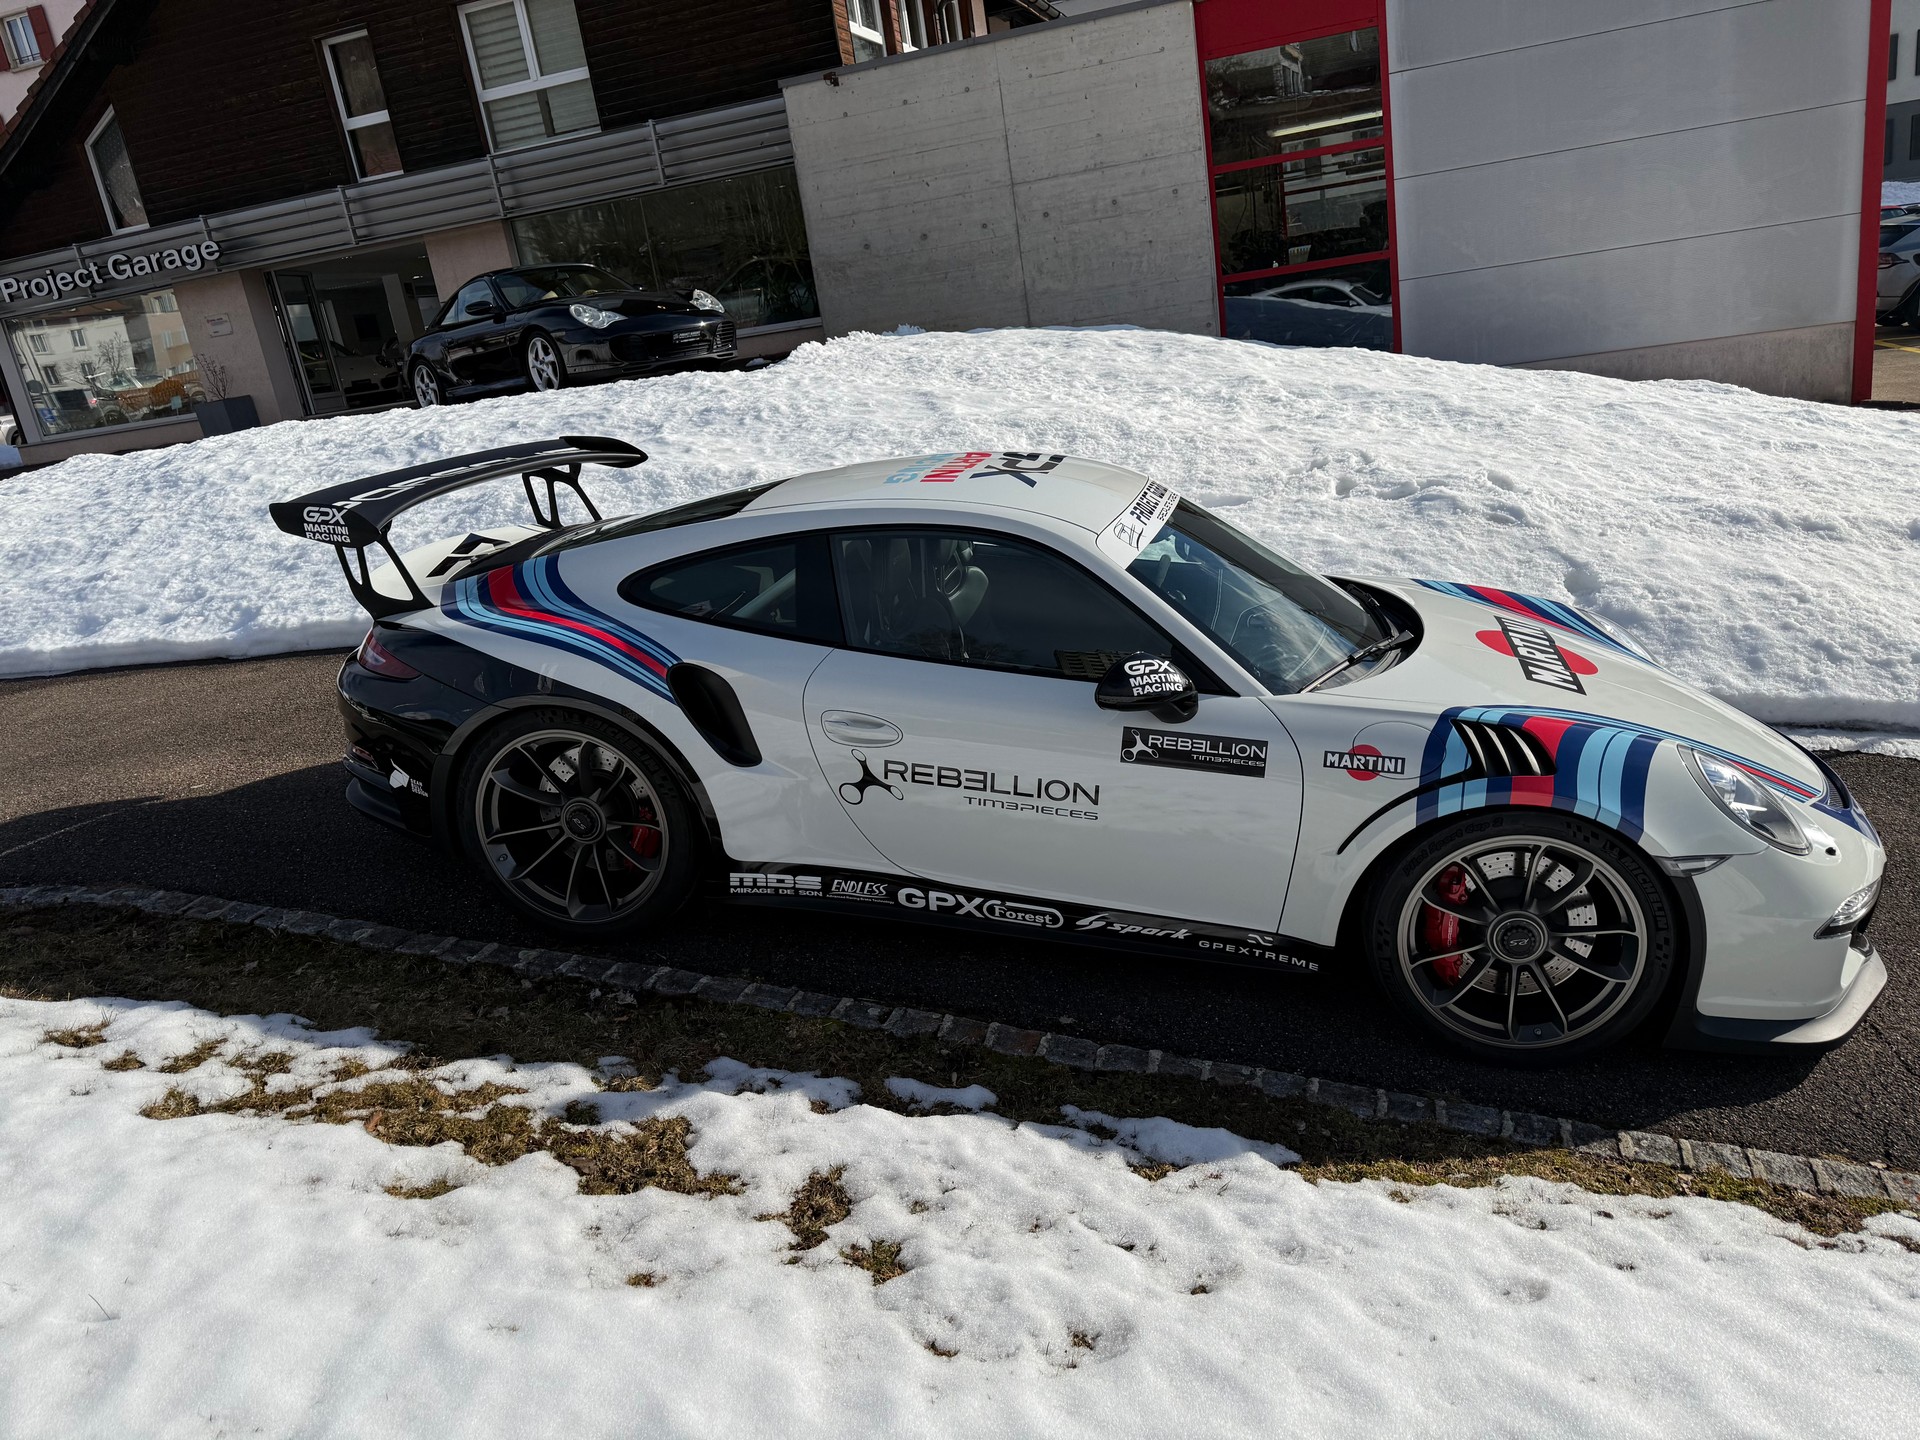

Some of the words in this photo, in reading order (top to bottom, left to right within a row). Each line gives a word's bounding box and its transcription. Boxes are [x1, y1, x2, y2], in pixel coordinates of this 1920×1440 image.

[0, 262, 104, 304] Project
[107, 240, 220, 280] Garage
[883, 453, 955, 484] ACING
[920, 452, 992, 482] ARTINI
[303, 506, 348, 525] GPX
[1129, 490, 1161, 526] PROJECT
[303, 523, 349, 535] MARTINI
[305, 531, 351, 543] RACING
[1501, 618, 1578, 690] MARTINI
[1124, 659, 1175, 675] GPX
[1132, 683, 1183, 697] RACING
[1326, 752, 1403, 773] MARTINI
[831, 879, 888, 896] ENDLESS
[1617, 850, 1669, 932] MICHELIN
[897, 887, 985, 918] GPX
[994, 905, 1053, 925] Forest
[1107, 922, 1193, 940] spark
[1199, 940, 1320, 972] GPEXTREME
